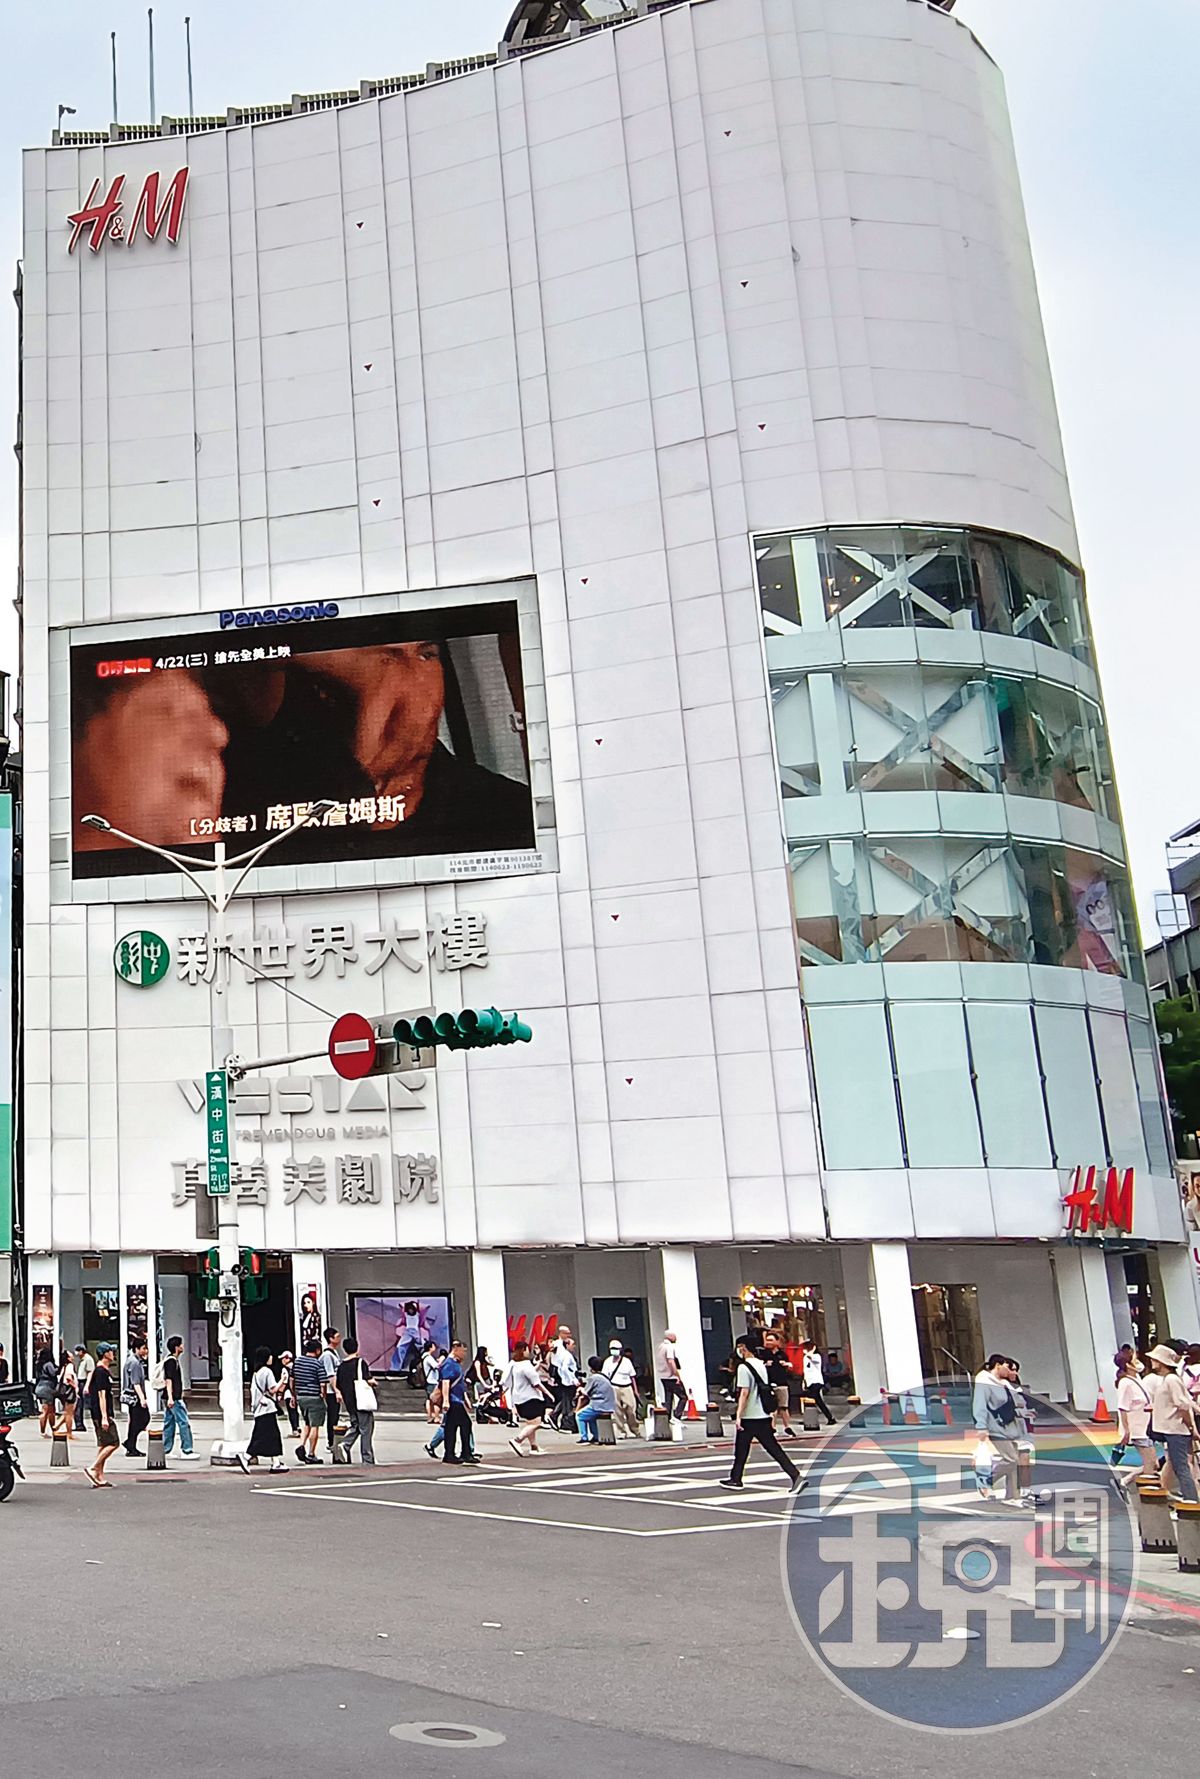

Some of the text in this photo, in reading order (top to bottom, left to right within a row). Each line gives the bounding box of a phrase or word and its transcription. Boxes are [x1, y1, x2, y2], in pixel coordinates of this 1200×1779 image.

[66, 165, 190, 255] H&M
[219, 602, 340, 629] Panasonic
[177, 911, 490, 985] 新世界大樓
[1063, 1165, 1135, 1235] H&M
